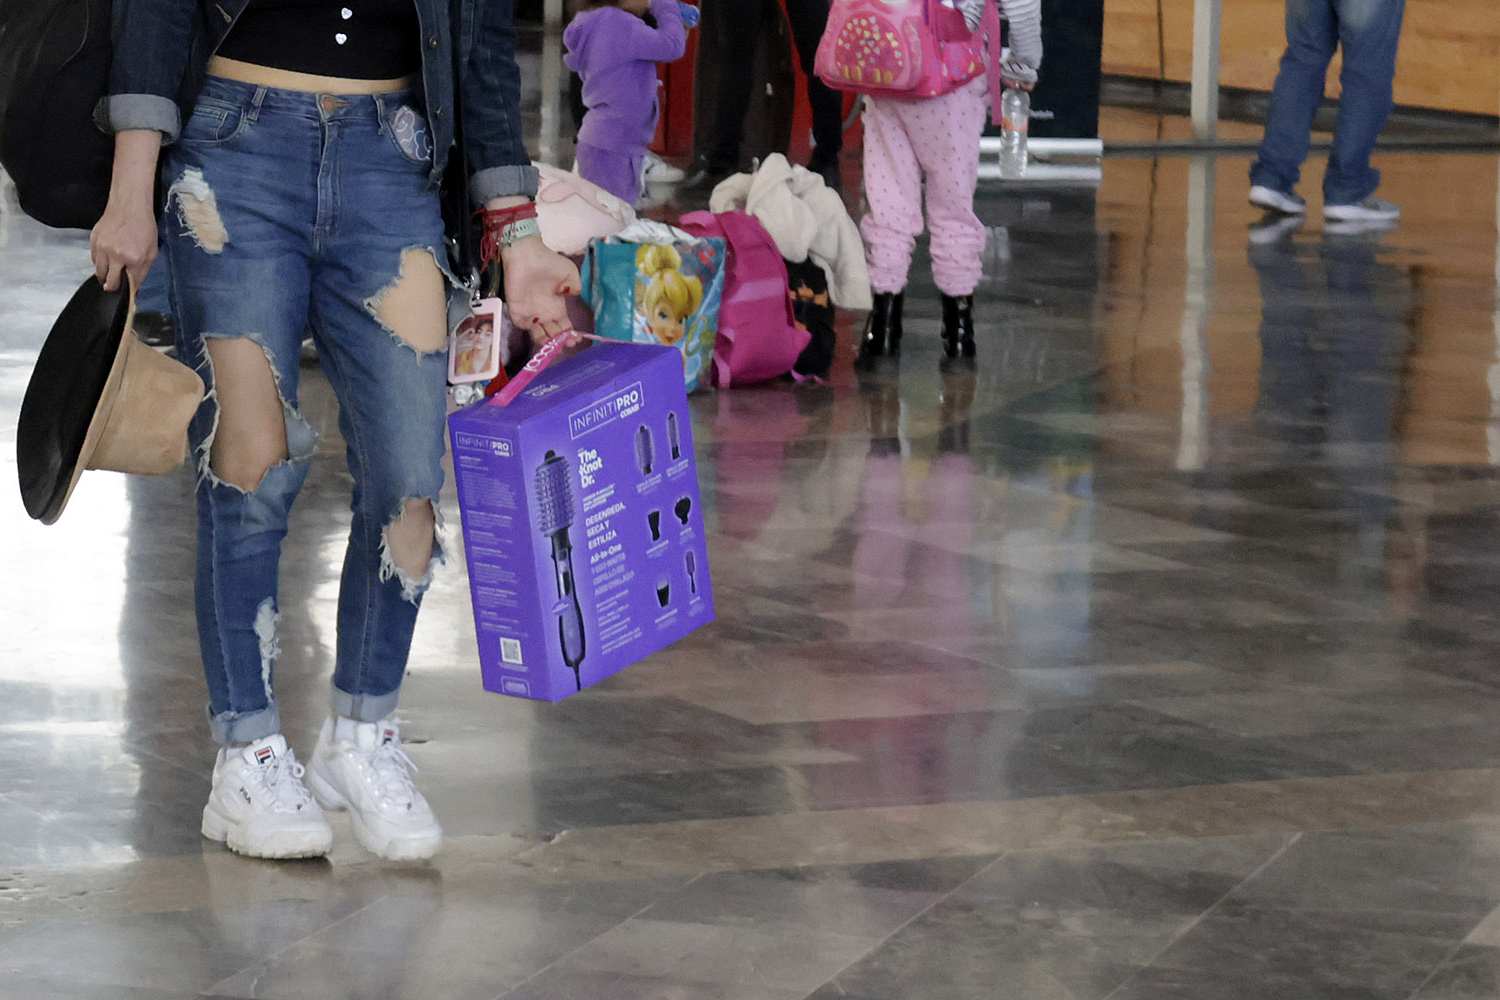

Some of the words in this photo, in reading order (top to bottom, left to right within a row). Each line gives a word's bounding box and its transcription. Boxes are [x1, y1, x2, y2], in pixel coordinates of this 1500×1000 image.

[578, 449, 597, 464] The
[579, 457, 603, 476] Knot
[581, 474, 596, 489] Dr.
[588, 529, 618, 550] ESTILIZA
[239, 786, 253, 805] FILA
